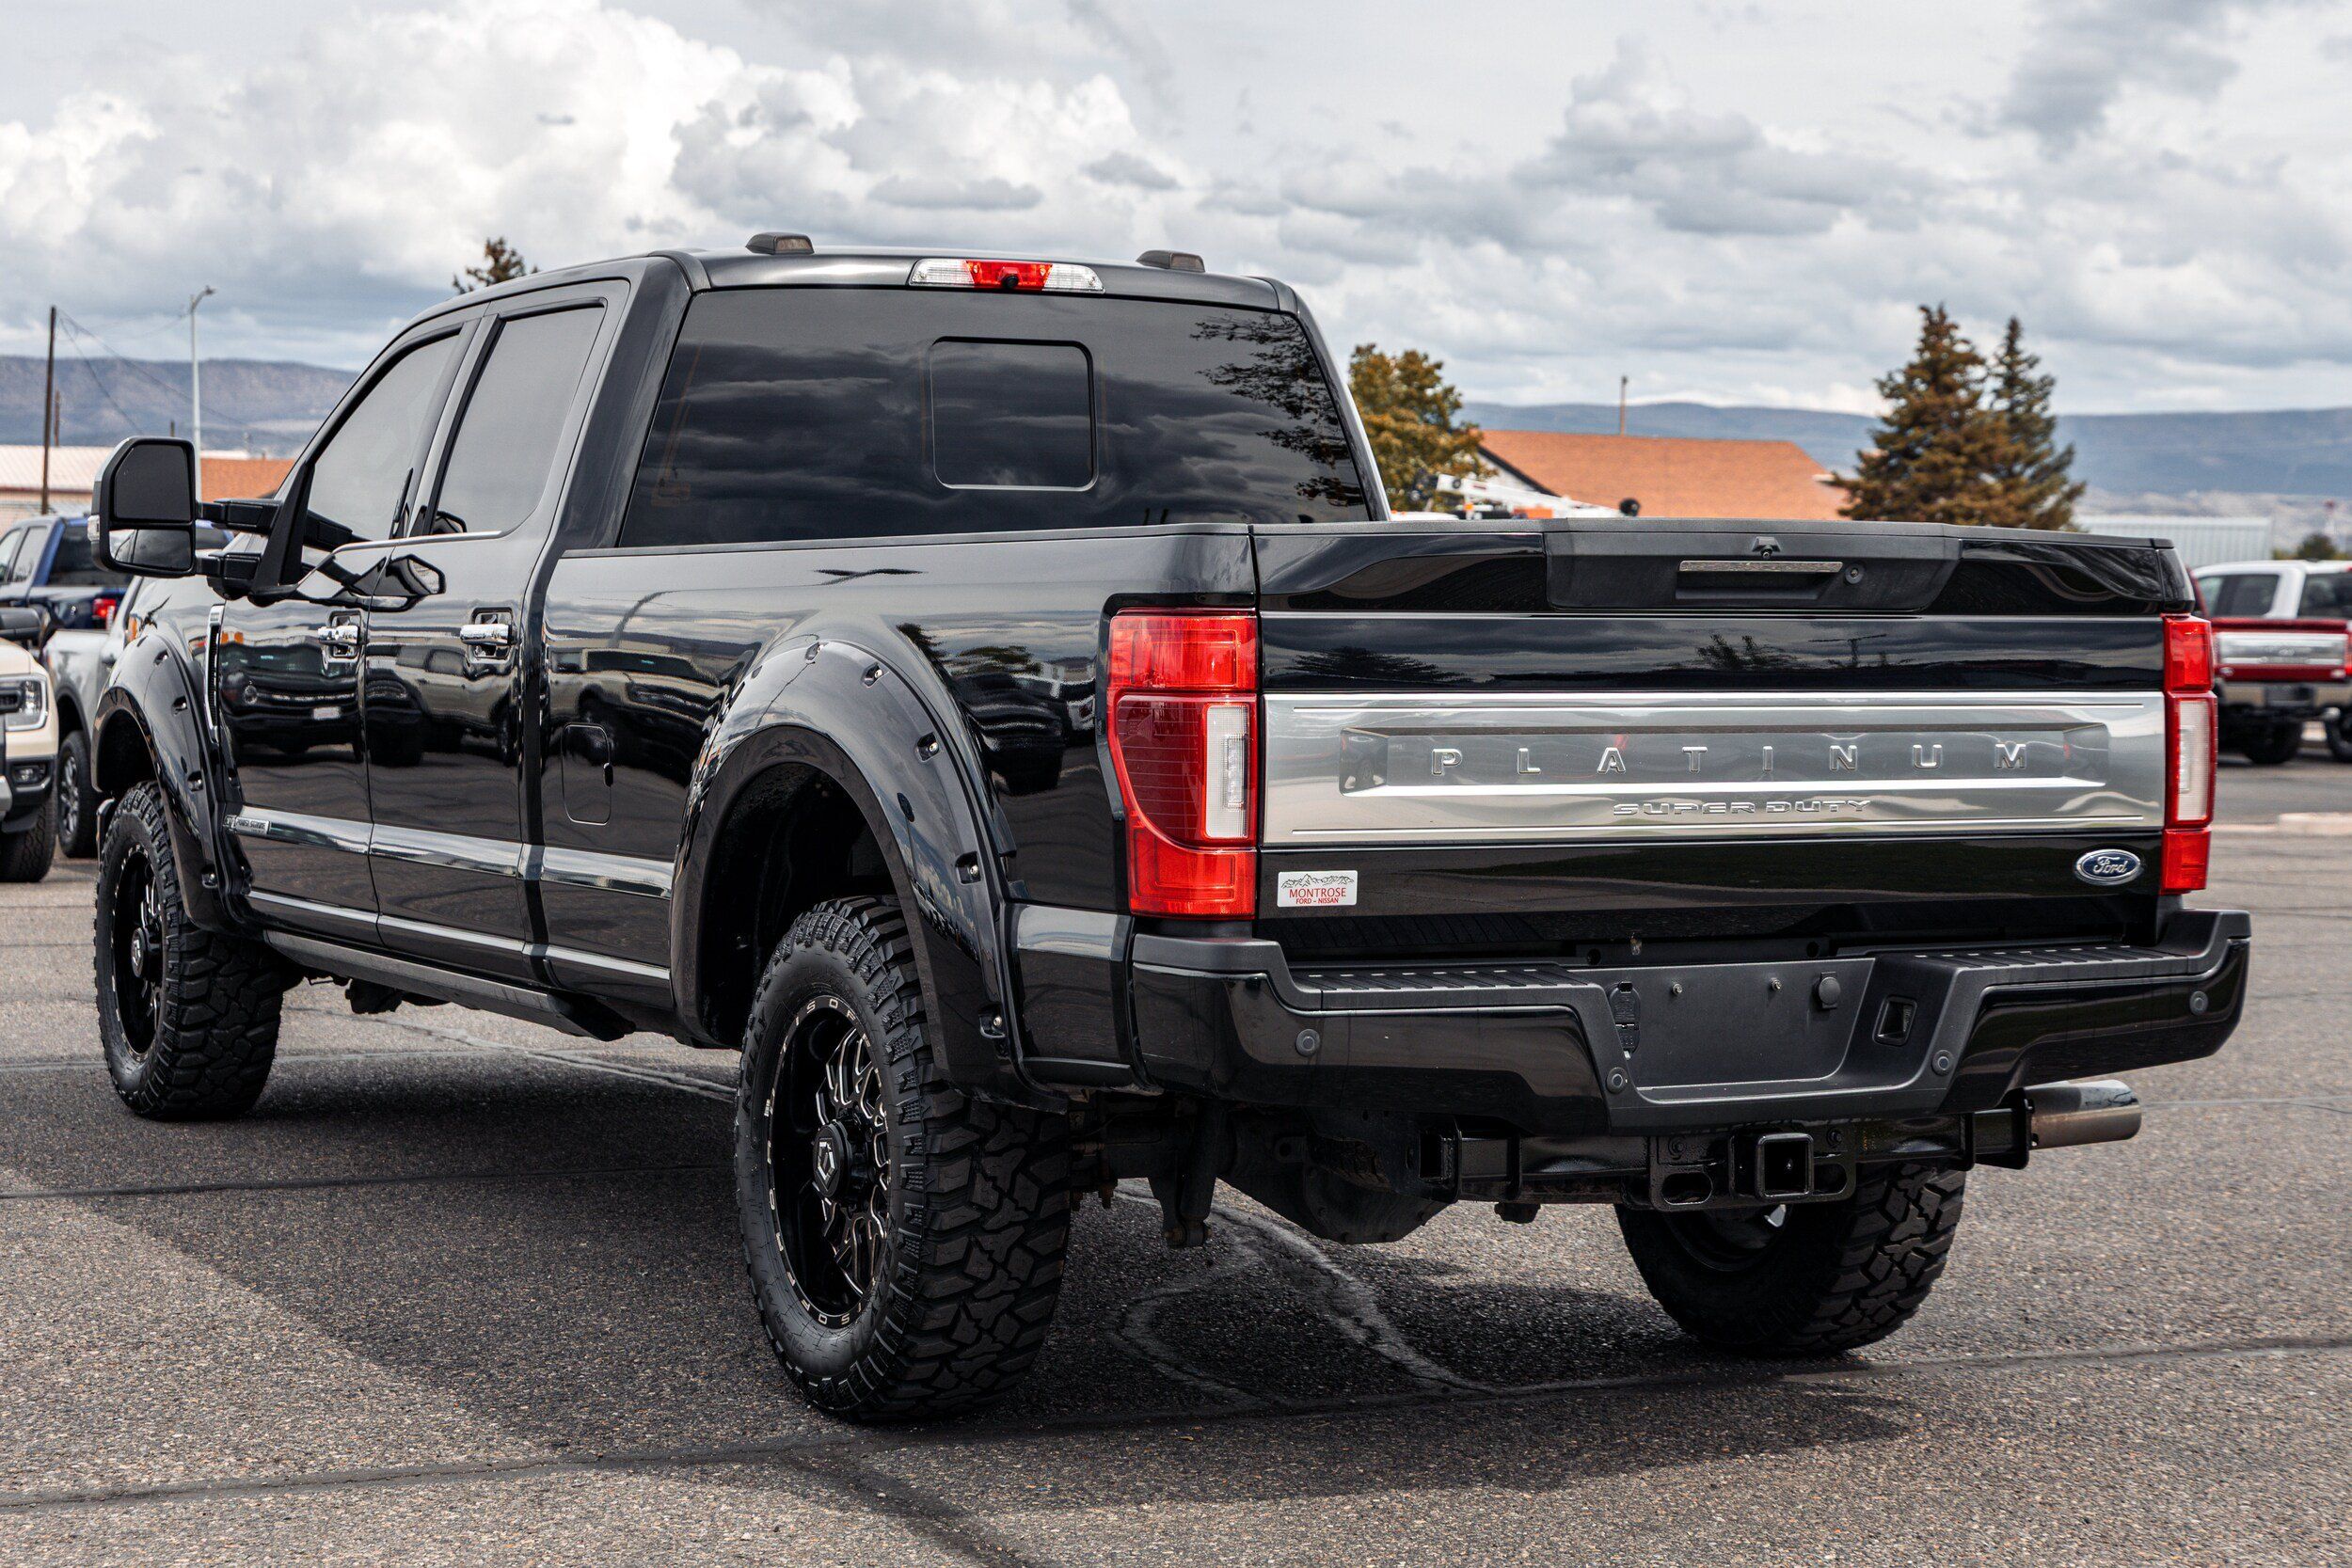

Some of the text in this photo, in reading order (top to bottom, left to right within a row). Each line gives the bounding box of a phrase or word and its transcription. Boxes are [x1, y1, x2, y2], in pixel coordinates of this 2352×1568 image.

[1430, 744, 2027, 775] PLATINUM
[1613, 800, 1871, 816] SUPER DUTY
[2093, 855, 2129, 875] Ford
[1289, 887, 1346, 898] MONTROSE
